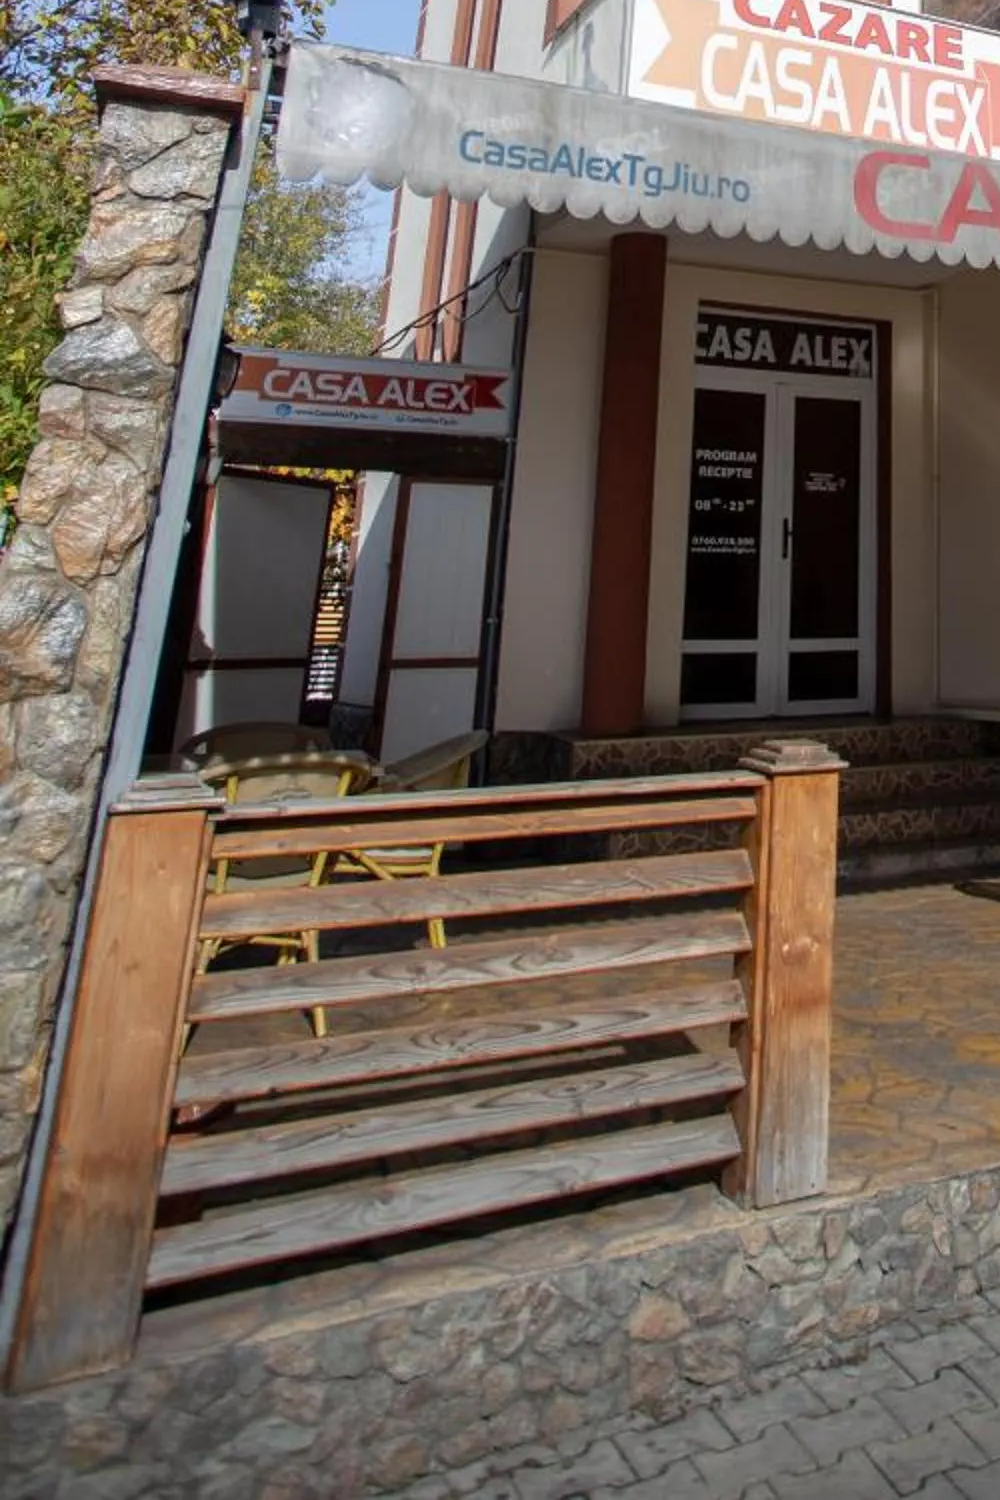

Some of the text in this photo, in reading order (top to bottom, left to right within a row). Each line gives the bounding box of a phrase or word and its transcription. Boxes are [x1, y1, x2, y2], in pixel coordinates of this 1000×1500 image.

[700, 33, 988, 156] CASA ALEX
[459, 129, 751, 203] CasaAlexTgJiu.ro
[695, 323, 870, 371] CASA ALEX
[263, 368, 472, 412] CASA ALEX
[695, 449, 758, 463] PROGRAM
